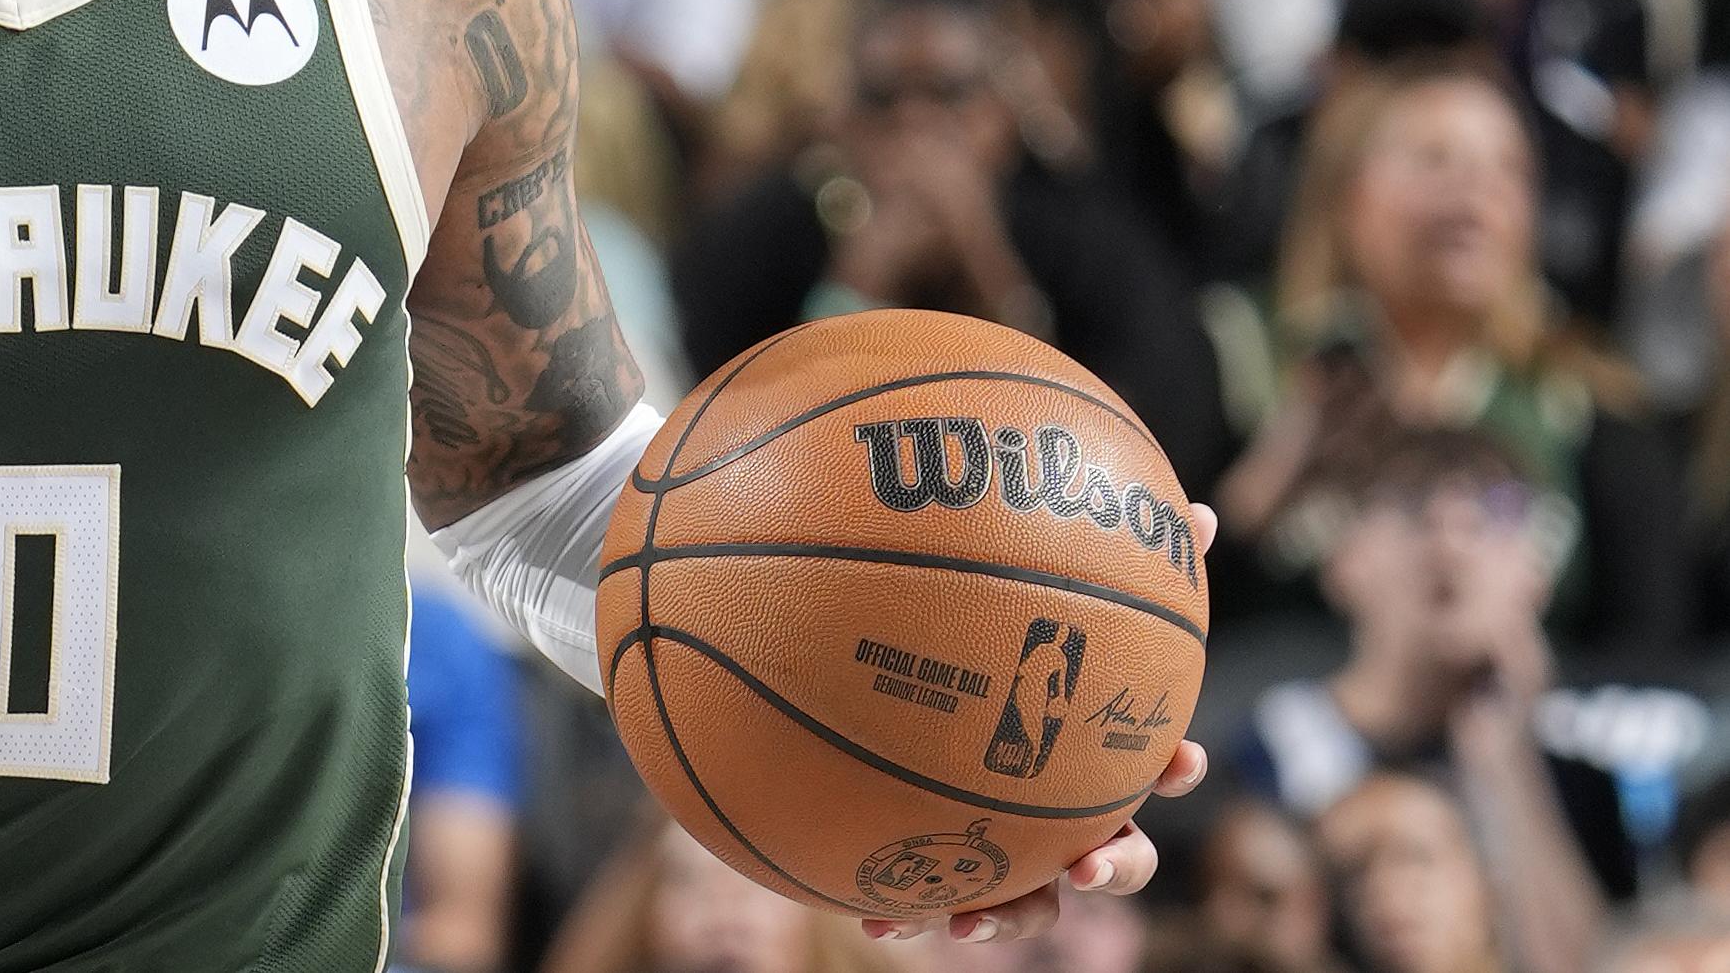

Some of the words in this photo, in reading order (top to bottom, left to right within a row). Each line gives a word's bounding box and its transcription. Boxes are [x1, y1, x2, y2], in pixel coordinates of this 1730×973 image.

[854, 417, 1198, 592] Wilson
[855, 638, 917, 677] OFFICIAL
[917, 657, 959, 689] GAME
[957, 669, 991, 698] BALL
[873, 673, 918, 703] GENUINE
[916, 686, 958, 714] LEATHER
